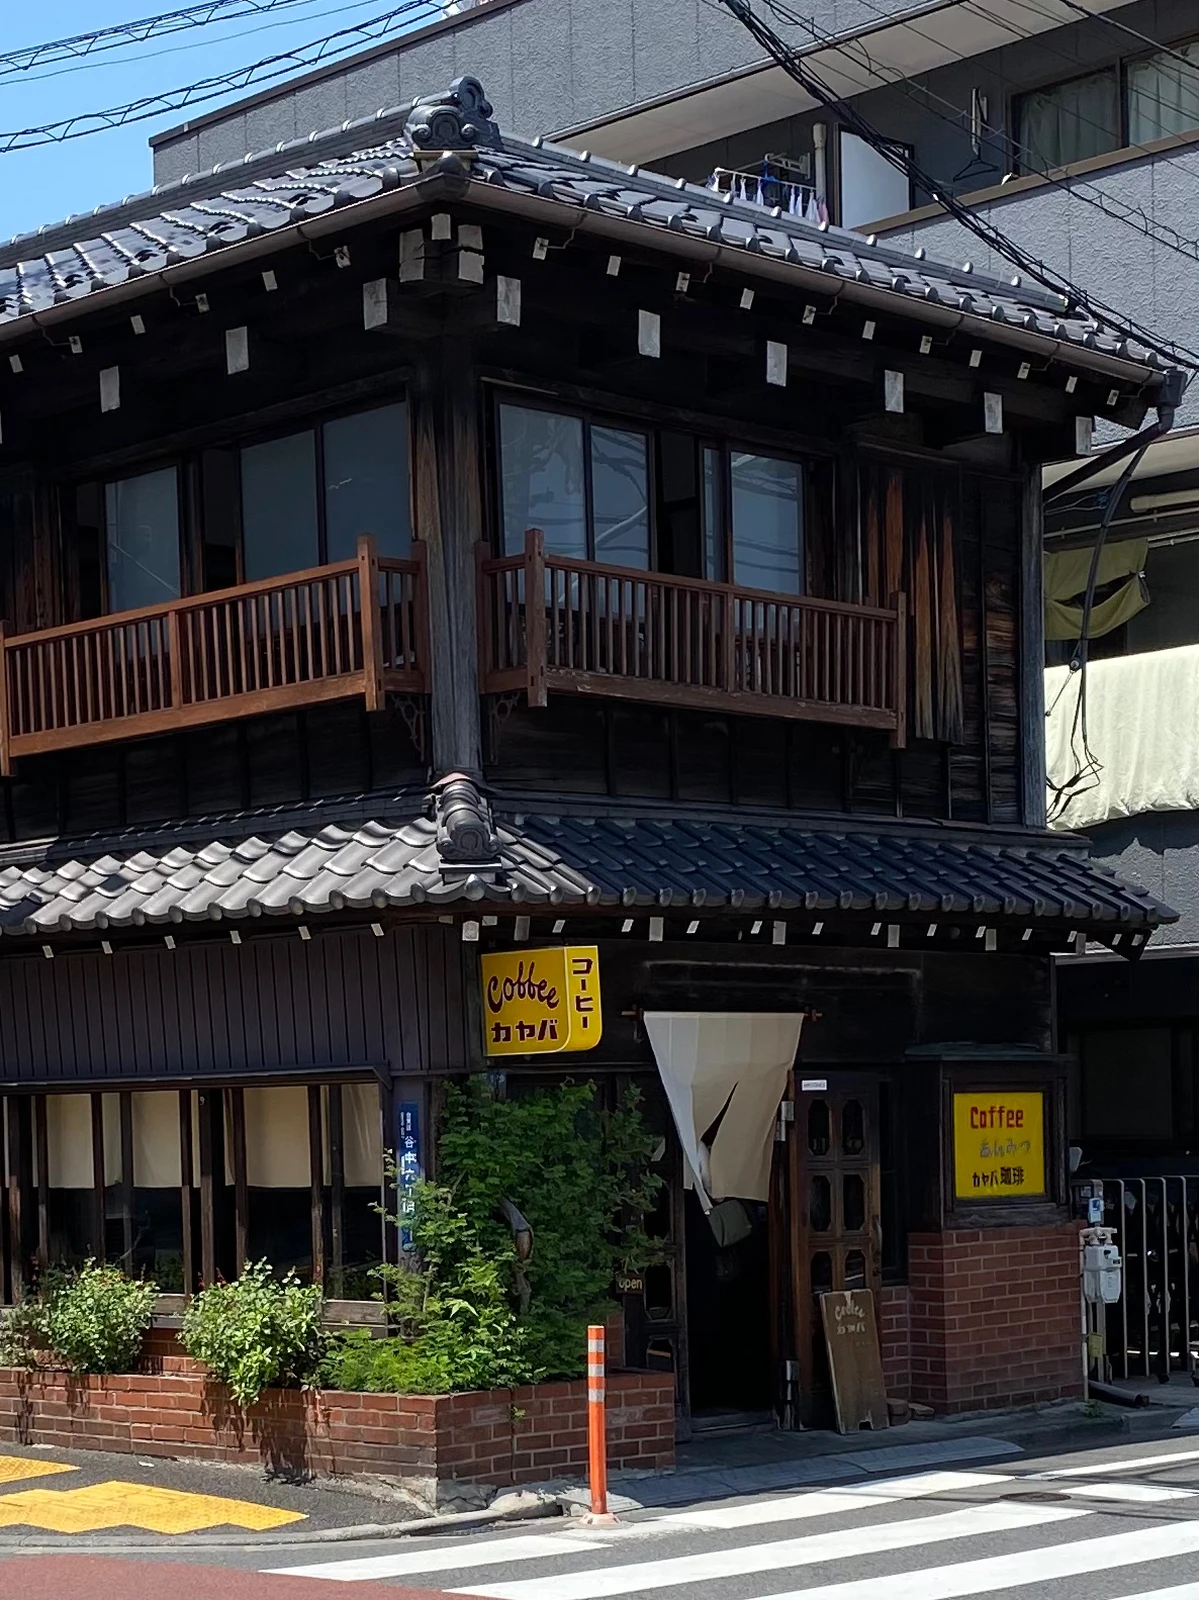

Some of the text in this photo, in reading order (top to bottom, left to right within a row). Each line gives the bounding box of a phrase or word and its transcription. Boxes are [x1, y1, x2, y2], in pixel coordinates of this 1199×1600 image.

[487, 960, 560, 1014] Coffee
[571, 957, 594, 1029] コーヒー
[490, 1018, 559, 1043] カヤバ
[970, 1105, 1024, 1130] Coffee
[971, 1165, 1025, 1188] カヤバ珈琲
[618, 1278, 643, 1292] open
